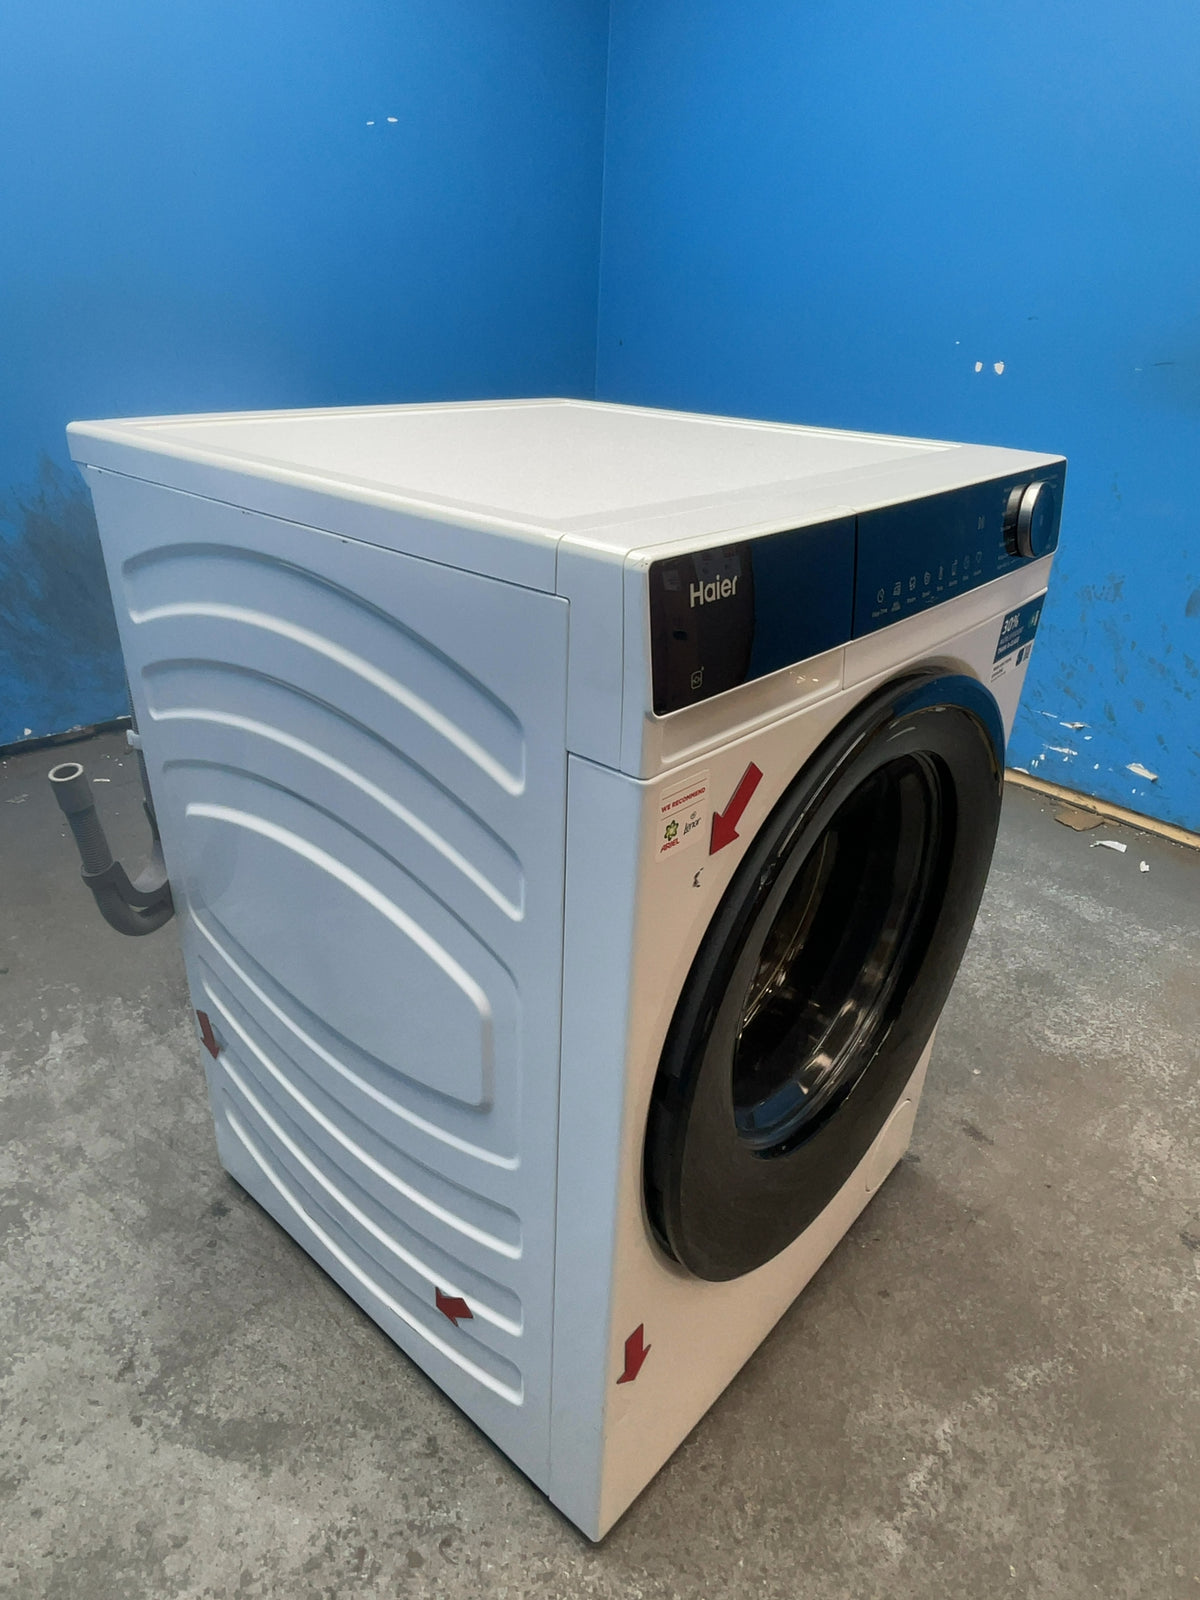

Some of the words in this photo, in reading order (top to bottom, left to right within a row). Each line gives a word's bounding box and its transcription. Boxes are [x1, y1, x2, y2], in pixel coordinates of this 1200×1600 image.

[690, 574, 738, 608] Haier
[661, 803, 671, 813] WE
[672, 787, 706, 808] RECOMMEND
[660, 838, 680, 853] ARIEL
